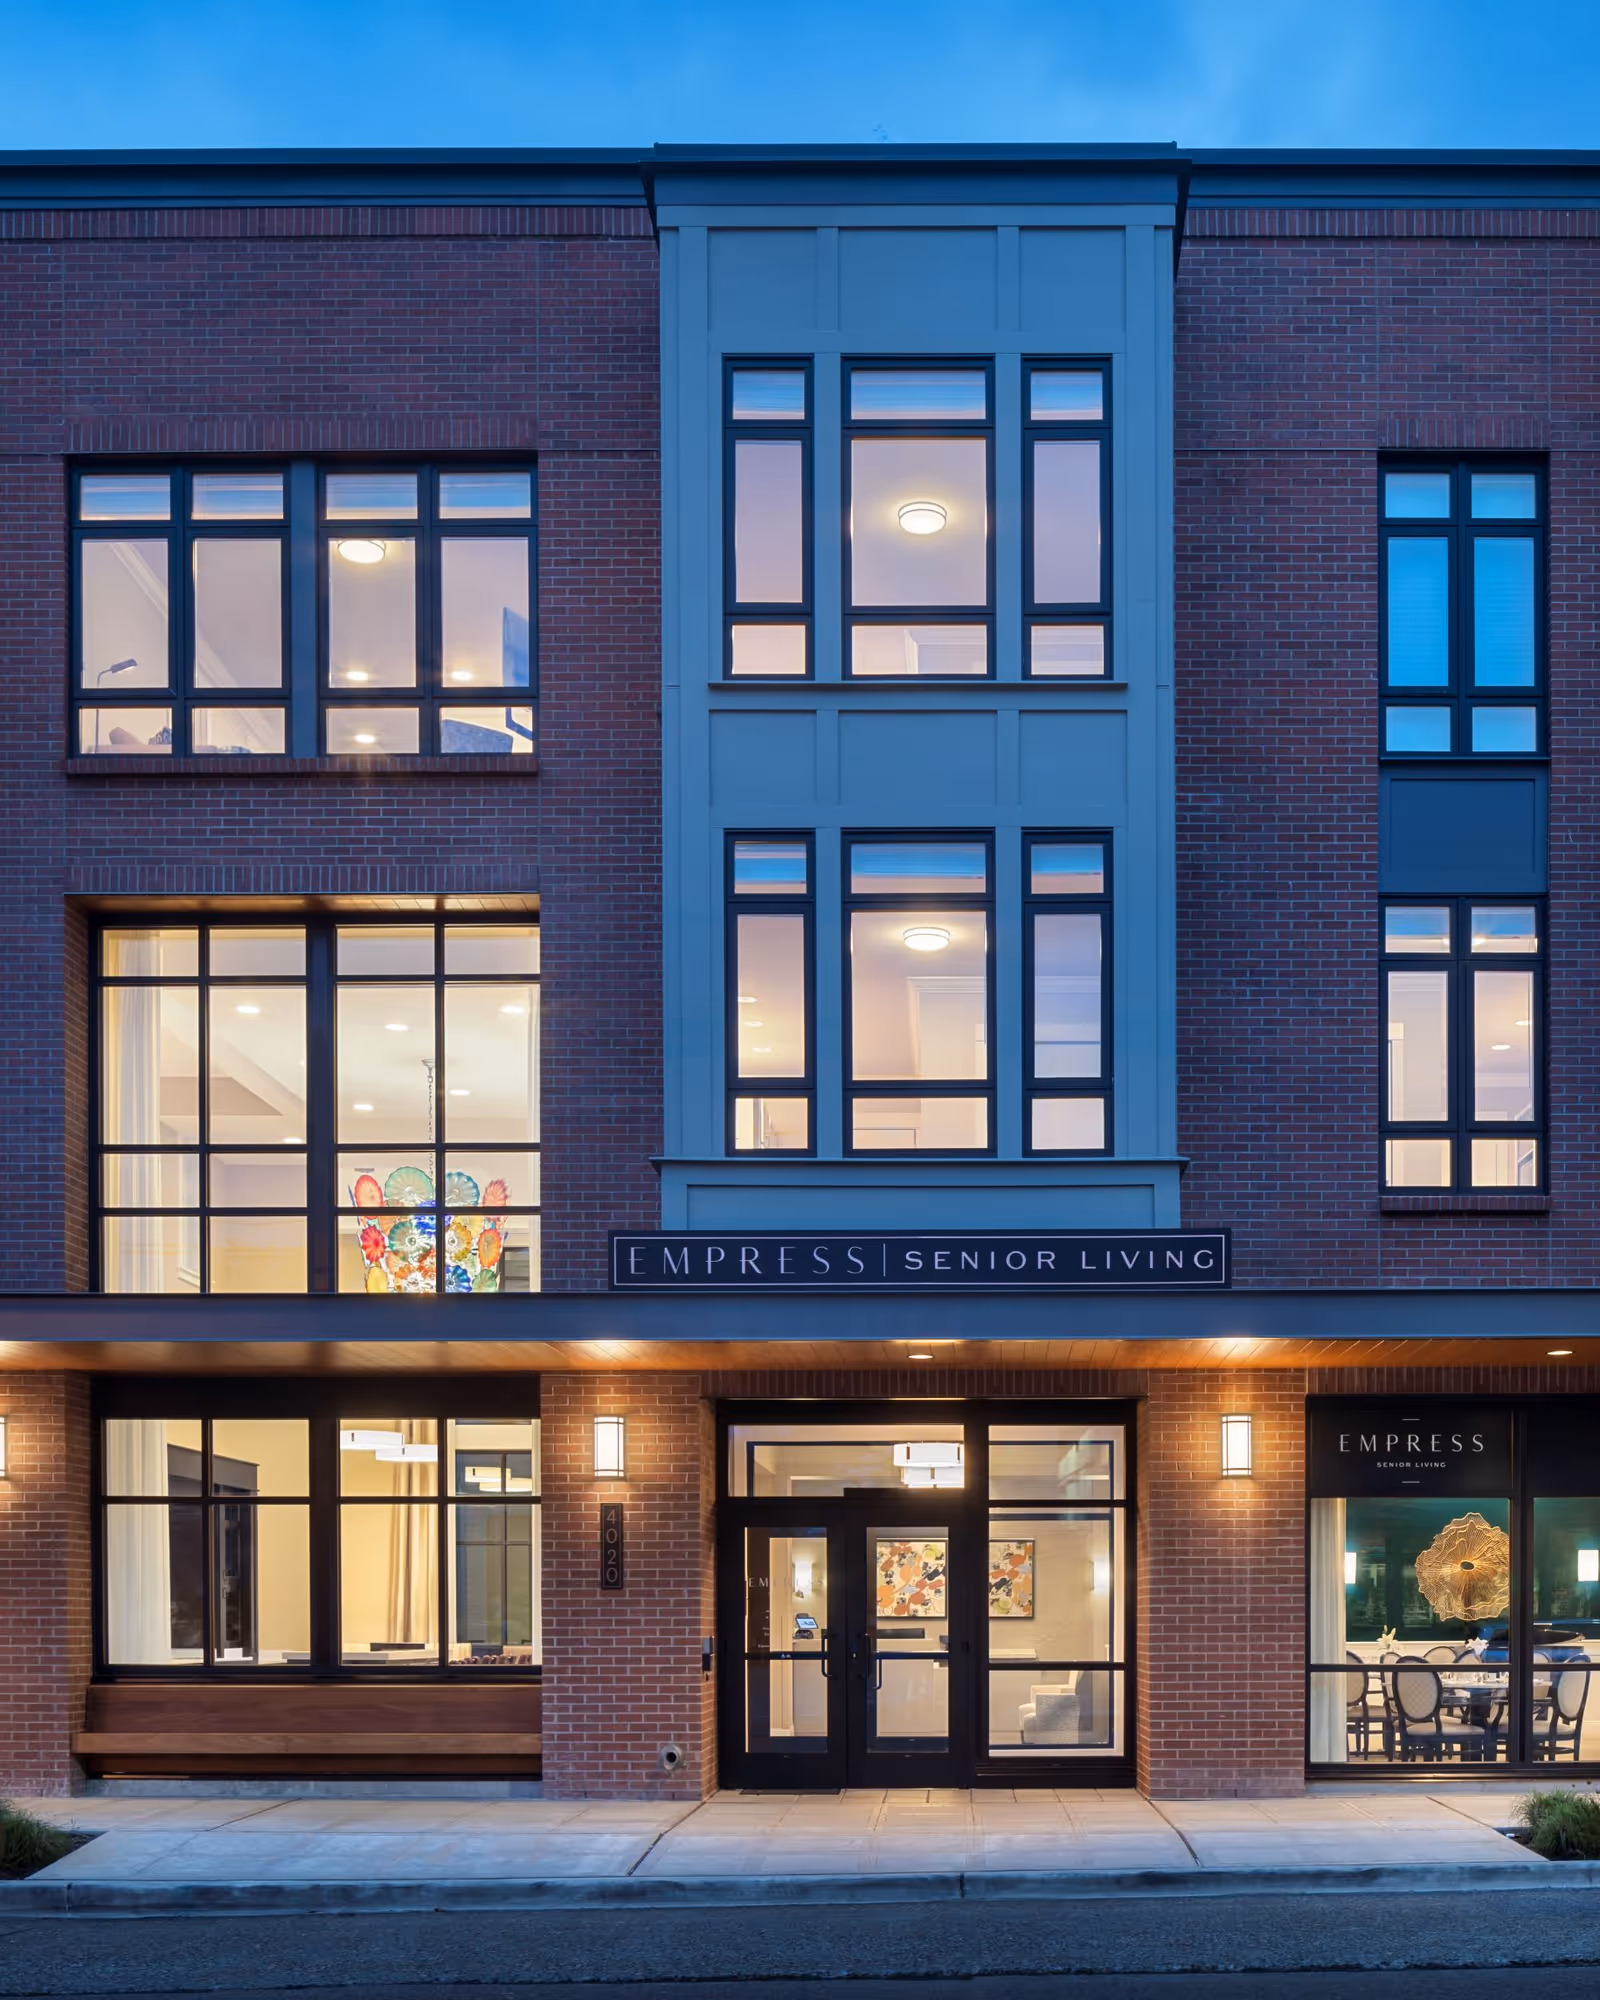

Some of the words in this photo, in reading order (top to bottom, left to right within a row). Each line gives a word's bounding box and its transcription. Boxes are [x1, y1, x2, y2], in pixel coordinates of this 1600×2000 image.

[628, 1246, 866, 1275] EMPRESS
[904, 1250, 1057, 1271] SENIOR
[1081, 1250, 1214, 1270] LIVING
[1338, 1433, 1485, 1453] EMPRESS
[1376, 1461, 1412, 1469] SENIOR
[1414, 1461, 1447, 1469] LIVING
[605, 1507, 619, 1584] 4020
